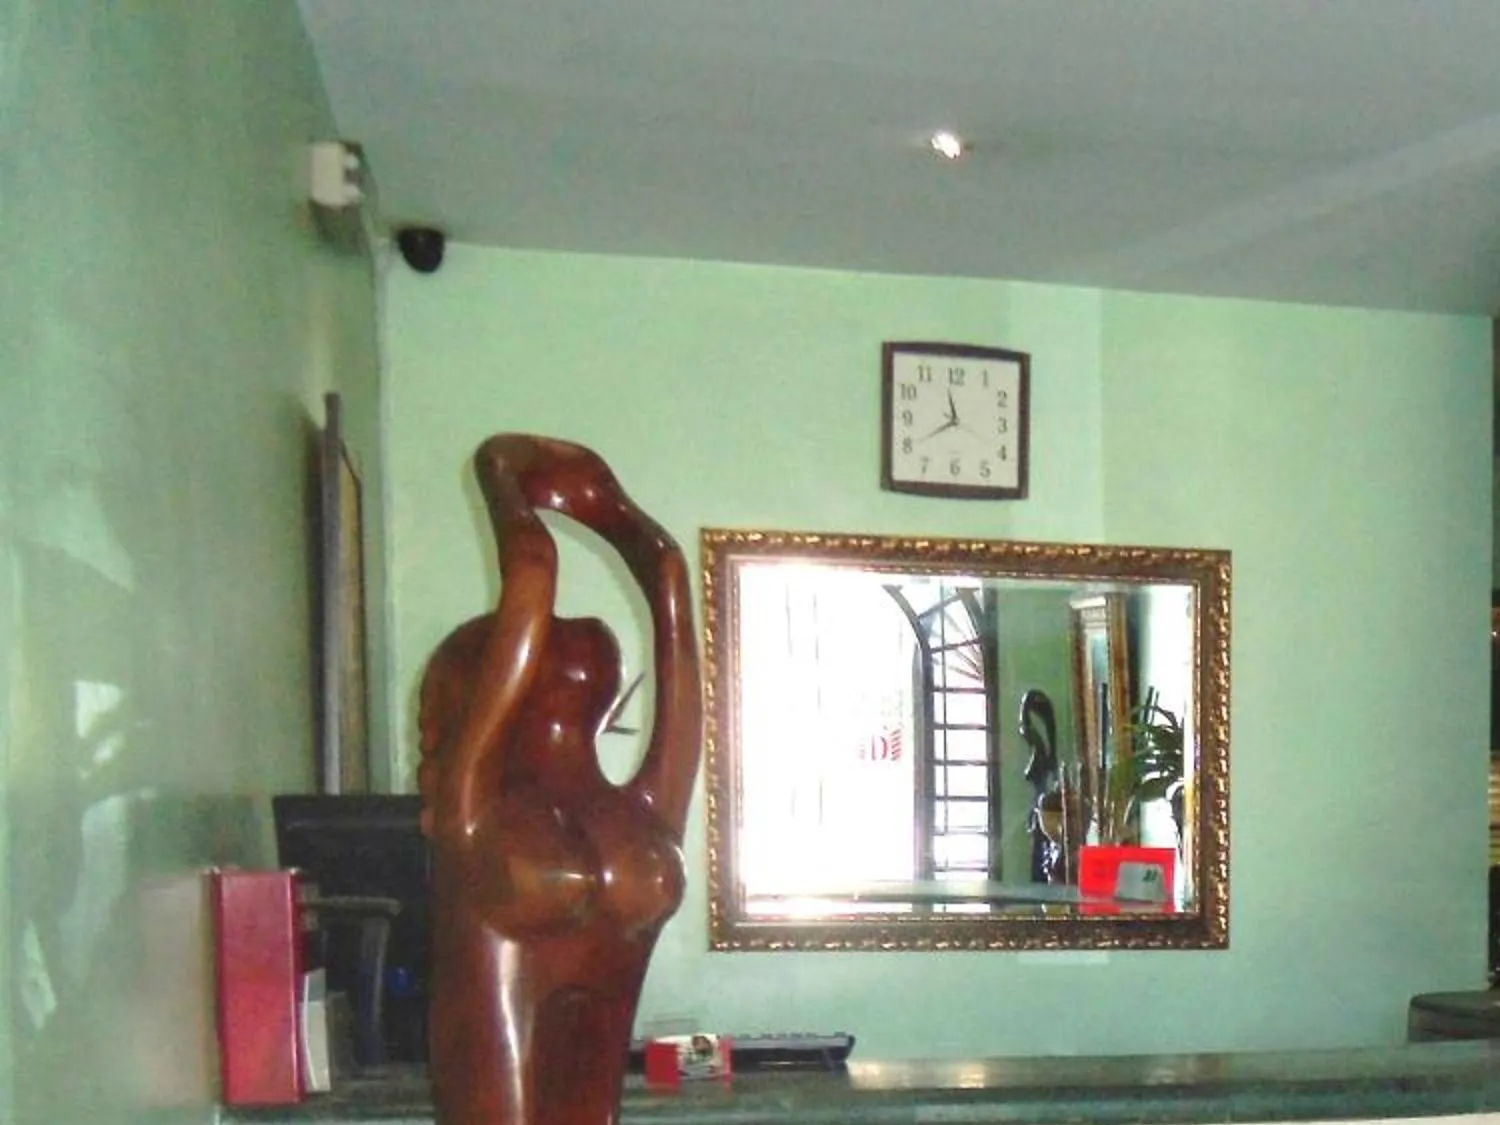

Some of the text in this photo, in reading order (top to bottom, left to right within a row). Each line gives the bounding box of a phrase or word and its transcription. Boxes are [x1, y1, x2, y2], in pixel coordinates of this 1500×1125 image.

[918, 365, 932, 383] 11
[948, 367, 965, 386] 12
[981, 369, 989, 388] 1
[900, 383, 917, 400] 10
[997, 390, 1008, 408] 2
[902, 410, 913, 426] 9
[997, 416, 1008, 434] 3
[902, 437, 913, 455] 8
[997, 444, 1007, 461] 4
[920, 456, 930, 474] 7
[950, 457, 960, 476] 6
[979, 460, 992, 478] 5
